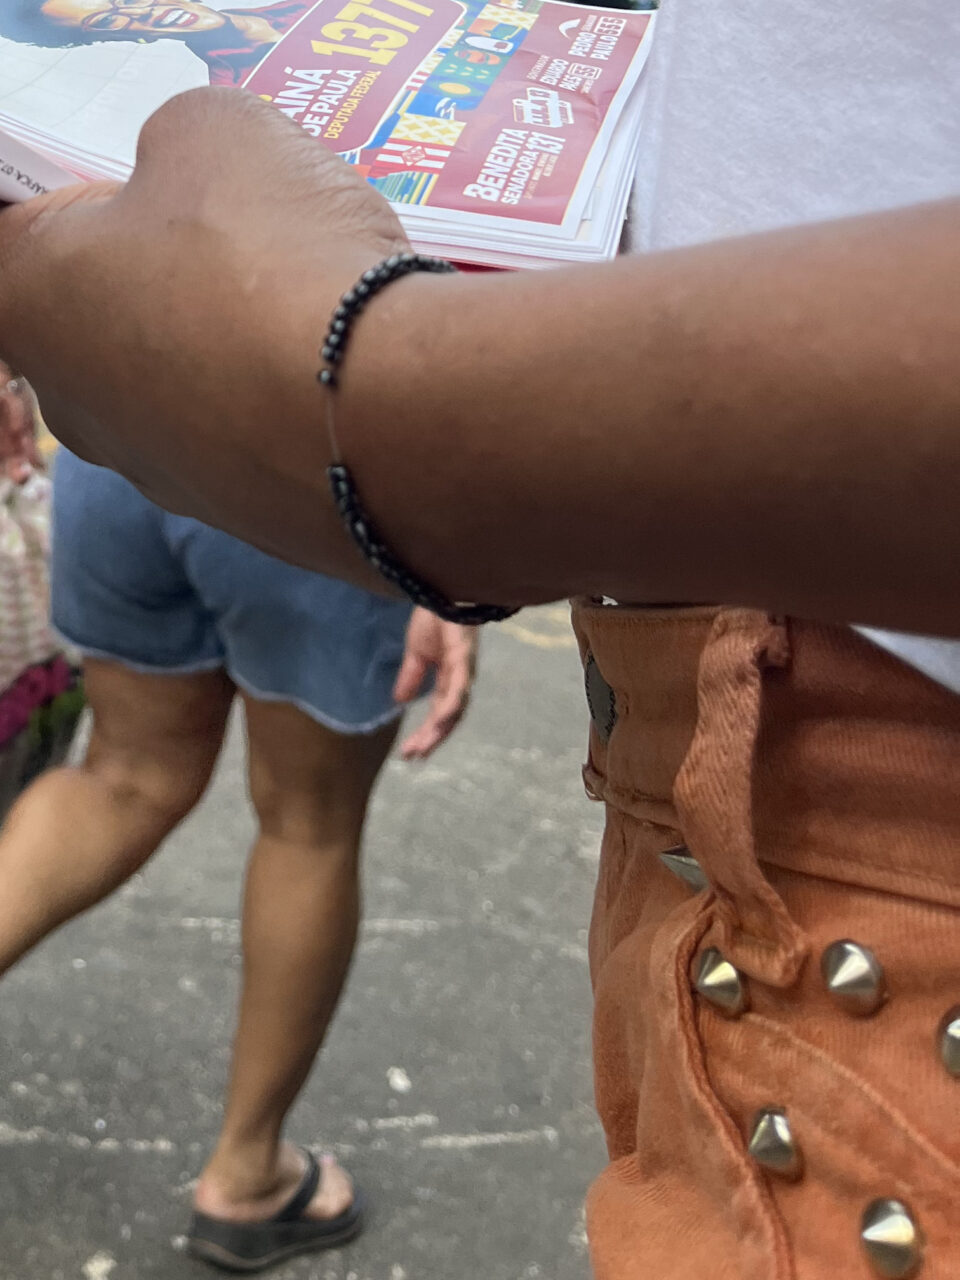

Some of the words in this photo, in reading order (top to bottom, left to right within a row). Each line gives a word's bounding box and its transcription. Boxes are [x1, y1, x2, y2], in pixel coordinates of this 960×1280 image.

[568, 32, 596, 57] PEDRO
[590, 35, 619, 60] PAULO
[275, 66, 333, 122] AINÁ
[315, 69, 362, 113] PAULA
[323, 100, 361, 139] DEPUTADA
[350, 71, 382, 102] FEDERAL
[463, 128, 529, 201] BENEDITA
[501, 143, 539, 205] SENADORA
[531, 131, 566, 155] 131
